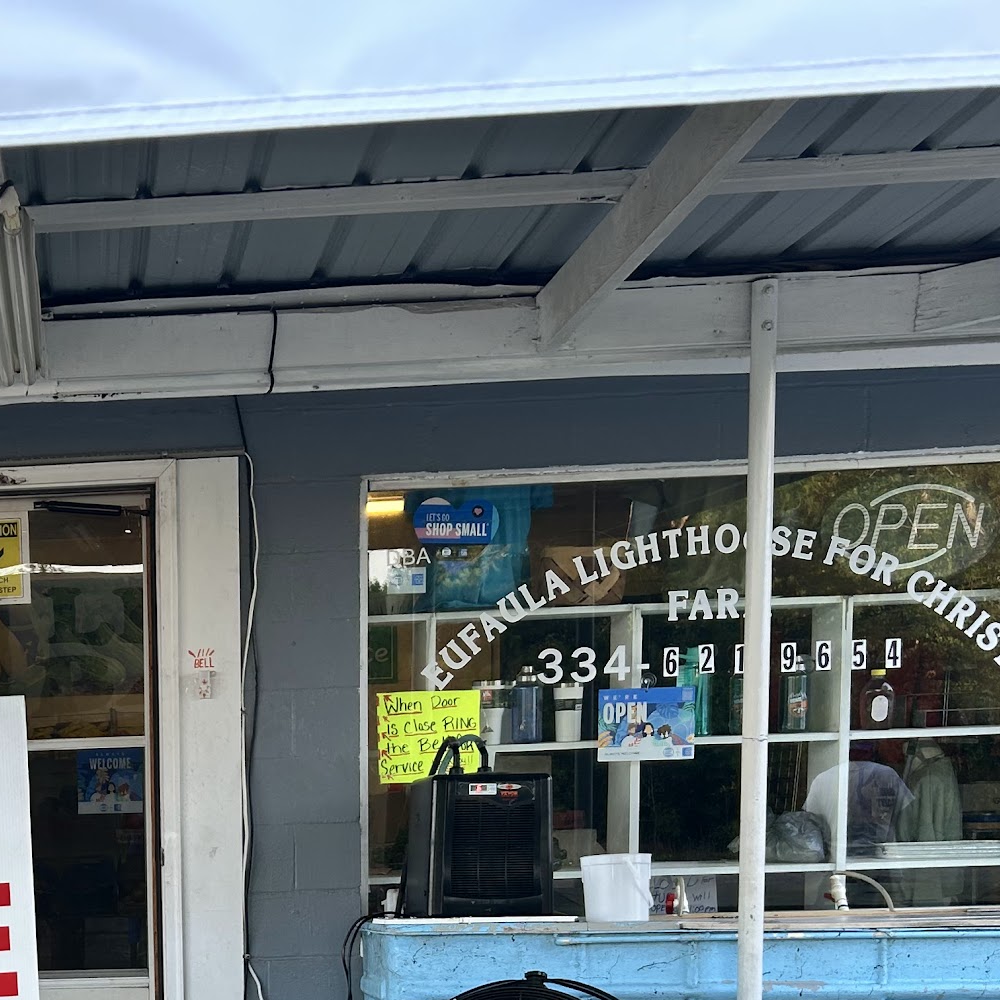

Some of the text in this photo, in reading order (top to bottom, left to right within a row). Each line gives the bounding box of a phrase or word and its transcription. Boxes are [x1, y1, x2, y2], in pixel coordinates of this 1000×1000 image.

[426, 513, 450, 522] LET'S GO
[833, 502, 985, 549] OPEN
[425, 523, 488, 536] SHOP SMALL
[387, 547, 431, 567] DBA
[421, 523, 1000, 691] EUFAULA LIGHTHOSE FOR CHRIS
[667, 588, 745, 622] FAR
[194, 656, 215, 669] BELL
[384, 696, 460, 713] When Door
[602, 701, 648, 725] OPEN
[442, 716, 477, 729] RING
[88, 757, 132, 770] WELCOME
[380, 759, 424, 776] Service
